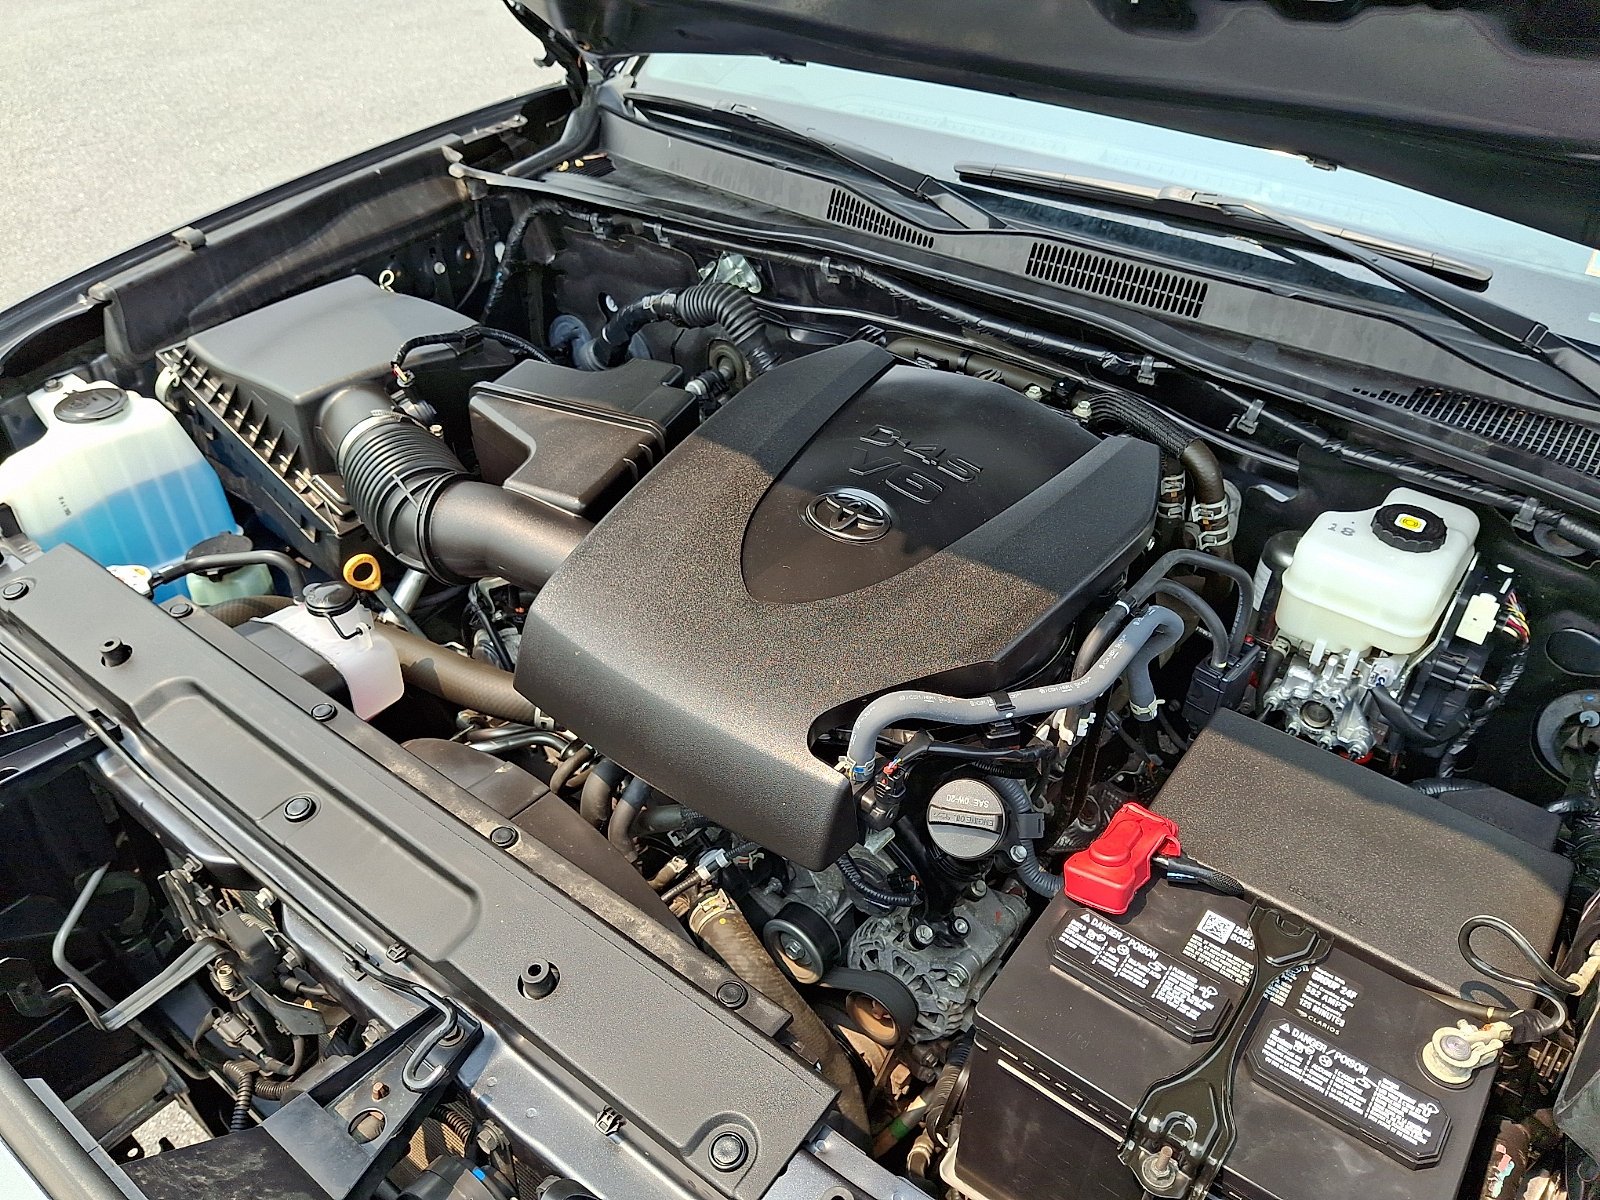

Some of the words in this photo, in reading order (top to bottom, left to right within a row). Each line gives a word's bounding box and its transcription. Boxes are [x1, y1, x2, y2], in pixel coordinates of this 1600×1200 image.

[860, 424, 984, 483] D-4S
[848, 446, 946, 505] V6
[974, 798, 990, 809] SAE
[1321, 993, 1347, 1011] AMPS
[1307, 1014, 1339, 1035] CLARIOS
[1311, 1004, 1345, 1027] MINUTES
